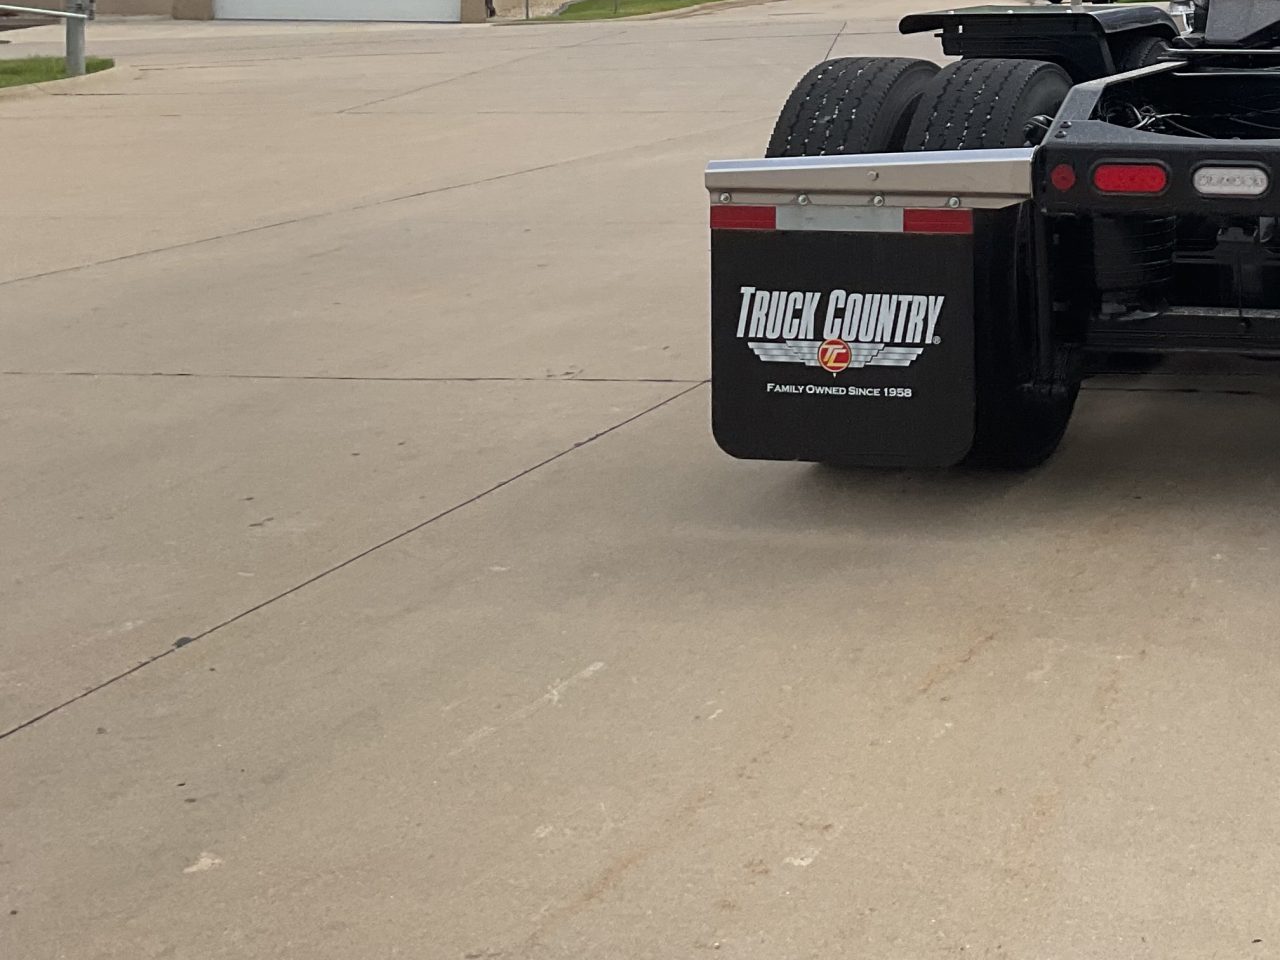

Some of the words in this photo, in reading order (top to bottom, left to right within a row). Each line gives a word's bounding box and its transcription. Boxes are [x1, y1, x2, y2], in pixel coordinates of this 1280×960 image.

[736, 286, 821, 340] TRUCK
[823, 289, 945, 344] COUNTRY
[766, 383, 804, 394] FAMILY
[805, 385, 847, 396] OWNED
[848, 386, 881, 397] SINCE
[883, 387, 912, 398] 1958
